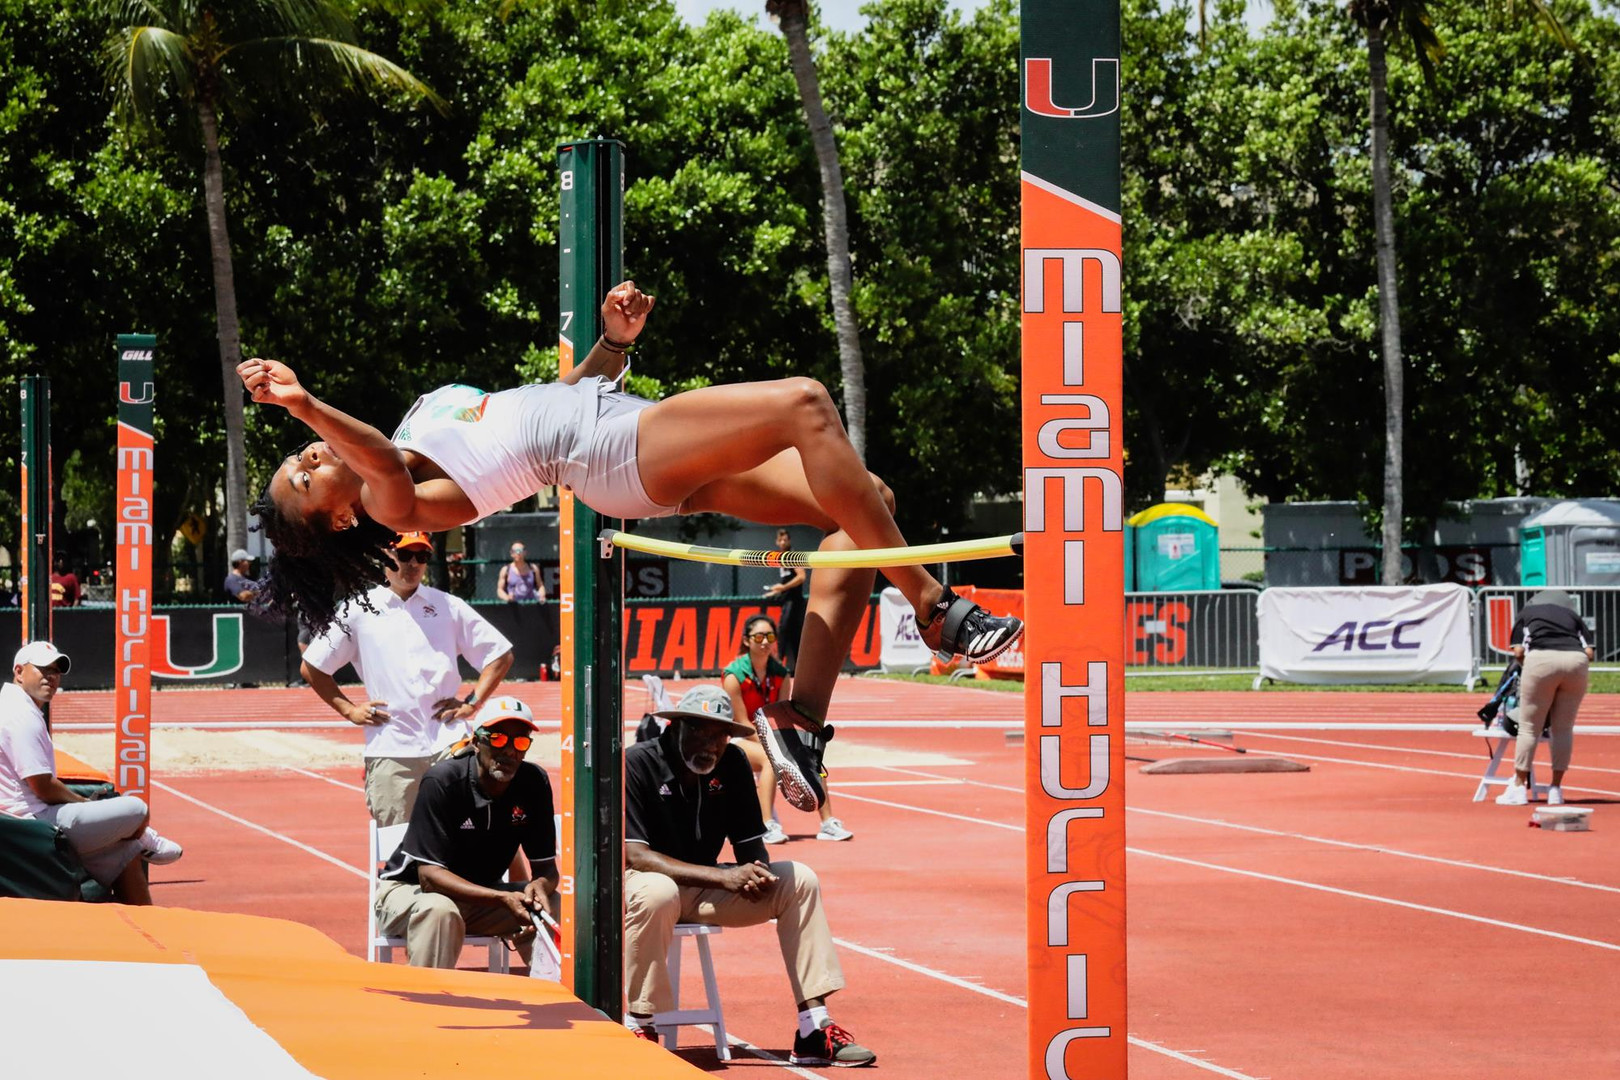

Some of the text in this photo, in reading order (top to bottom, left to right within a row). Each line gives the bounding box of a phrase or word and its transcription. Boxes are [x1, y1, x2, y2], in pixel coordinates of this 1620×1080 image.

[1025, 58, 1119, 118] U
[560, 170, 574, 191] 8
[560, 311, 574, 332] 7
[121, 350, 153, 361] GILL
[119, 381, 154, 404] U
[560, 593, 575, 613] 5
[1311, 616, 1427, 652] ACC
[151, 613, 244, 680] U
[561, 735, 575, 754] 4
[561, 875, 575, 895] 3
